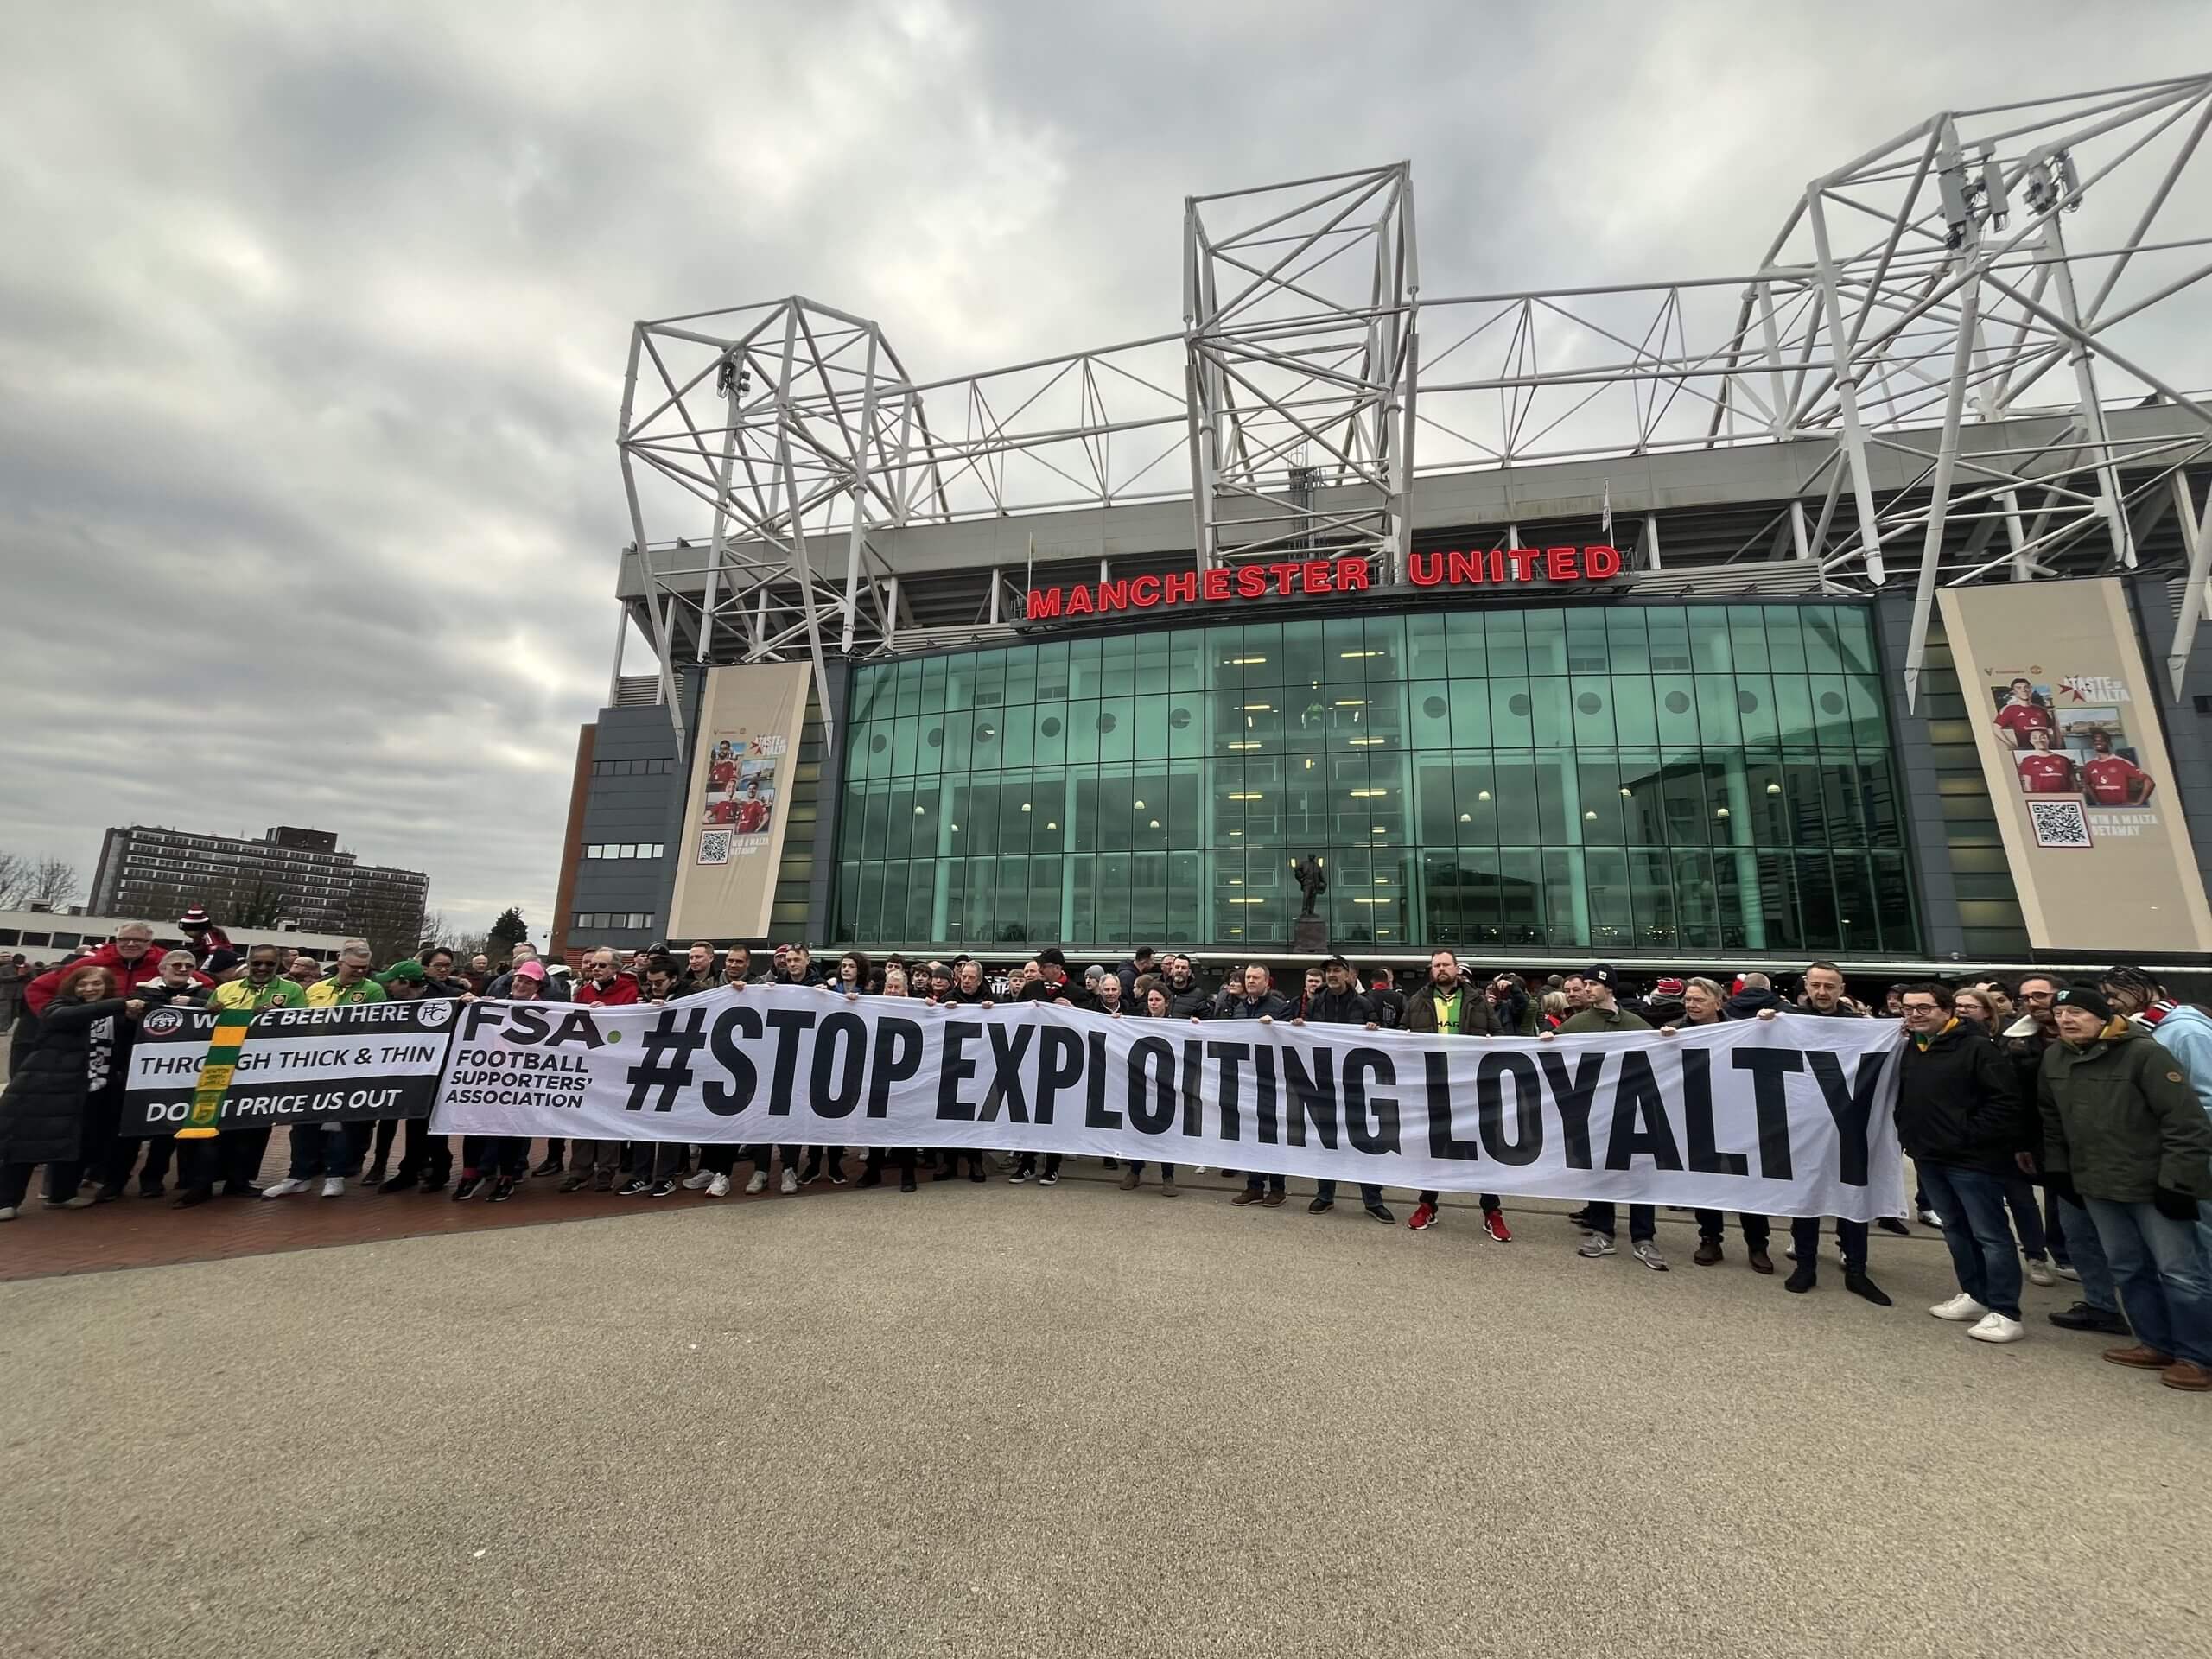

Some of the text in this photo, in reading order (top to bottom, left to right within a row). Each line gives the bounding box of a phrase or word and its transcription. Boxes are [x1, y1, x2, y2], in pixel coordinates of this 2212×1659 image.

[1027, 545, 1622, 620] MANCHESTER UNITED
[151, 1019, 176, 1027] FST
[280, 1007, 344, 1026] BEEN
[350, 1005, 411, 1023] HERE
[462, 1001, 607, 1050] FSA
[141, 1046, 435, 1075] THROGH THICK & THIN
[455, 1049, 588, 1074] FOOTBALL
[450, 1071, 593, 1091] SUPPORTERS'
[146, 1090, 403, 1122] DOT PRICE US OUT
[445, 1090, 583, 1109] ASSOCIATION
[625, 1006, 1892, 1187] #STOP EXPLOITING LOYALTY
